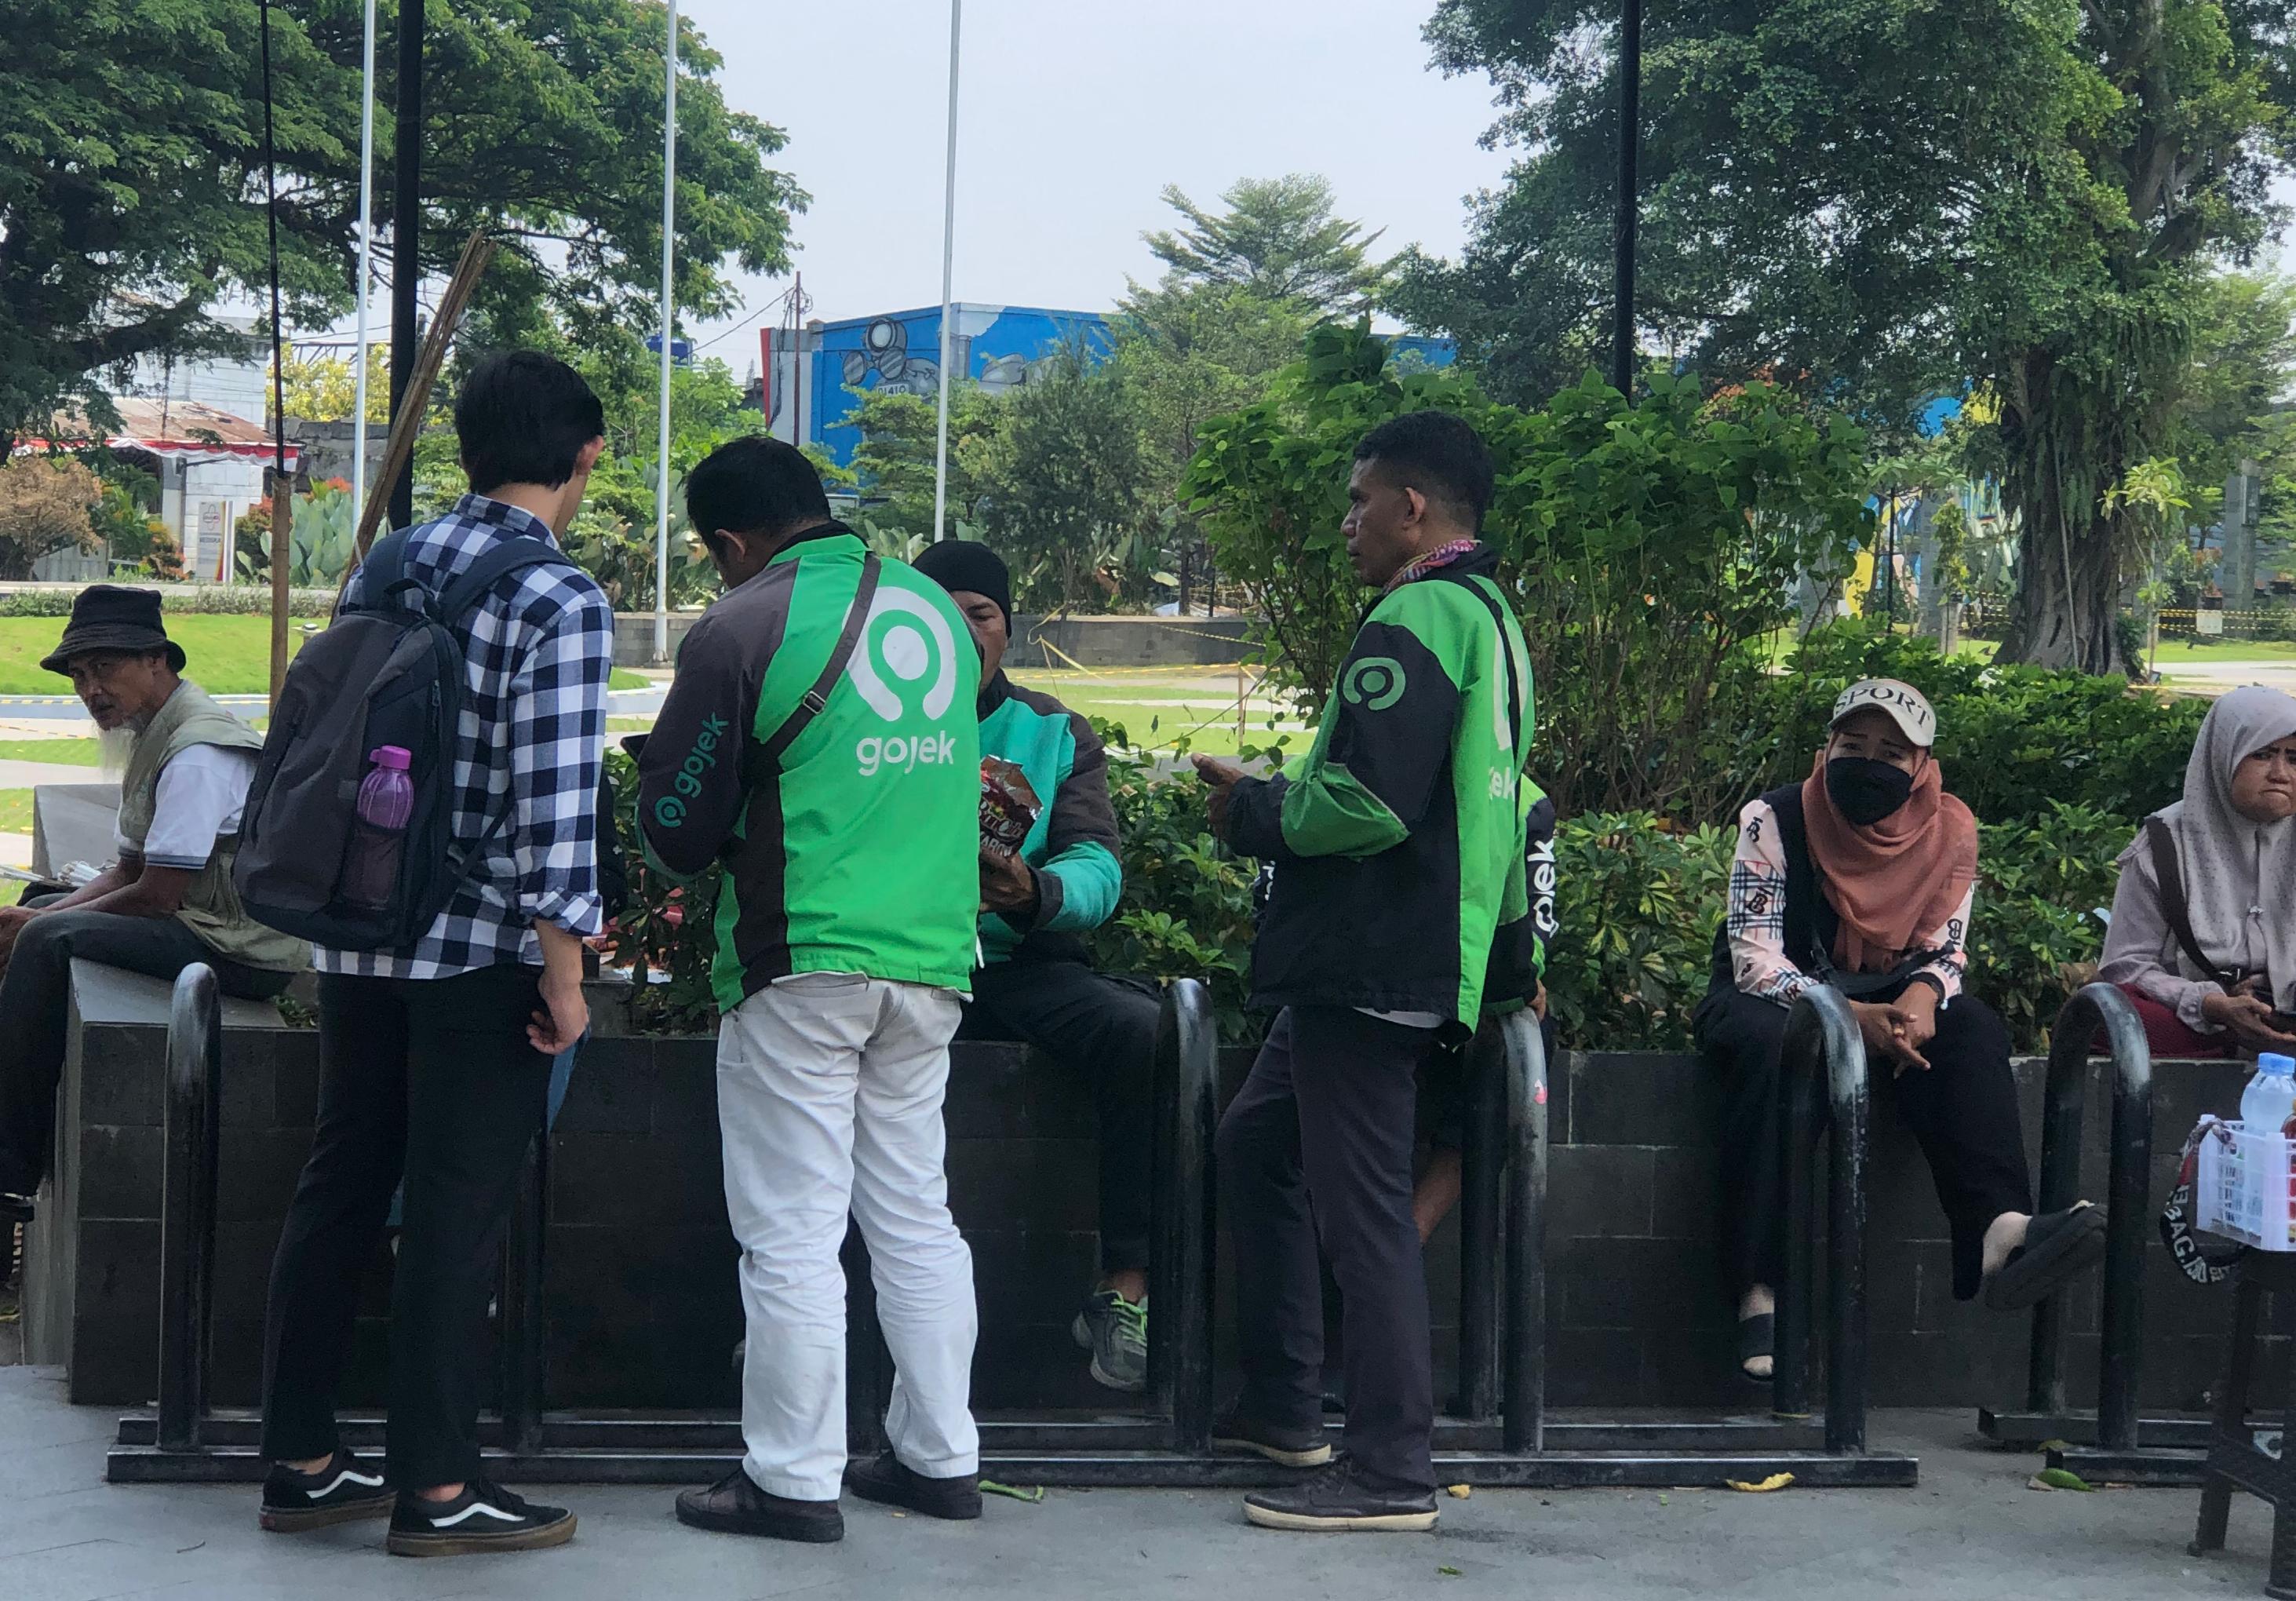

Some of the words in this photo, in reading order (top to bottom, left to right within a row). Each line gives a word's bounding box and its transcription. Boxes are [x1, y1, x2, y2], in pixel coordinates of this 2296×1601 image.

[1835, 687, 1930, 727] SPORT
[674, 711, 729, 798] gojek
[856, 730, 957, 776] gojek
